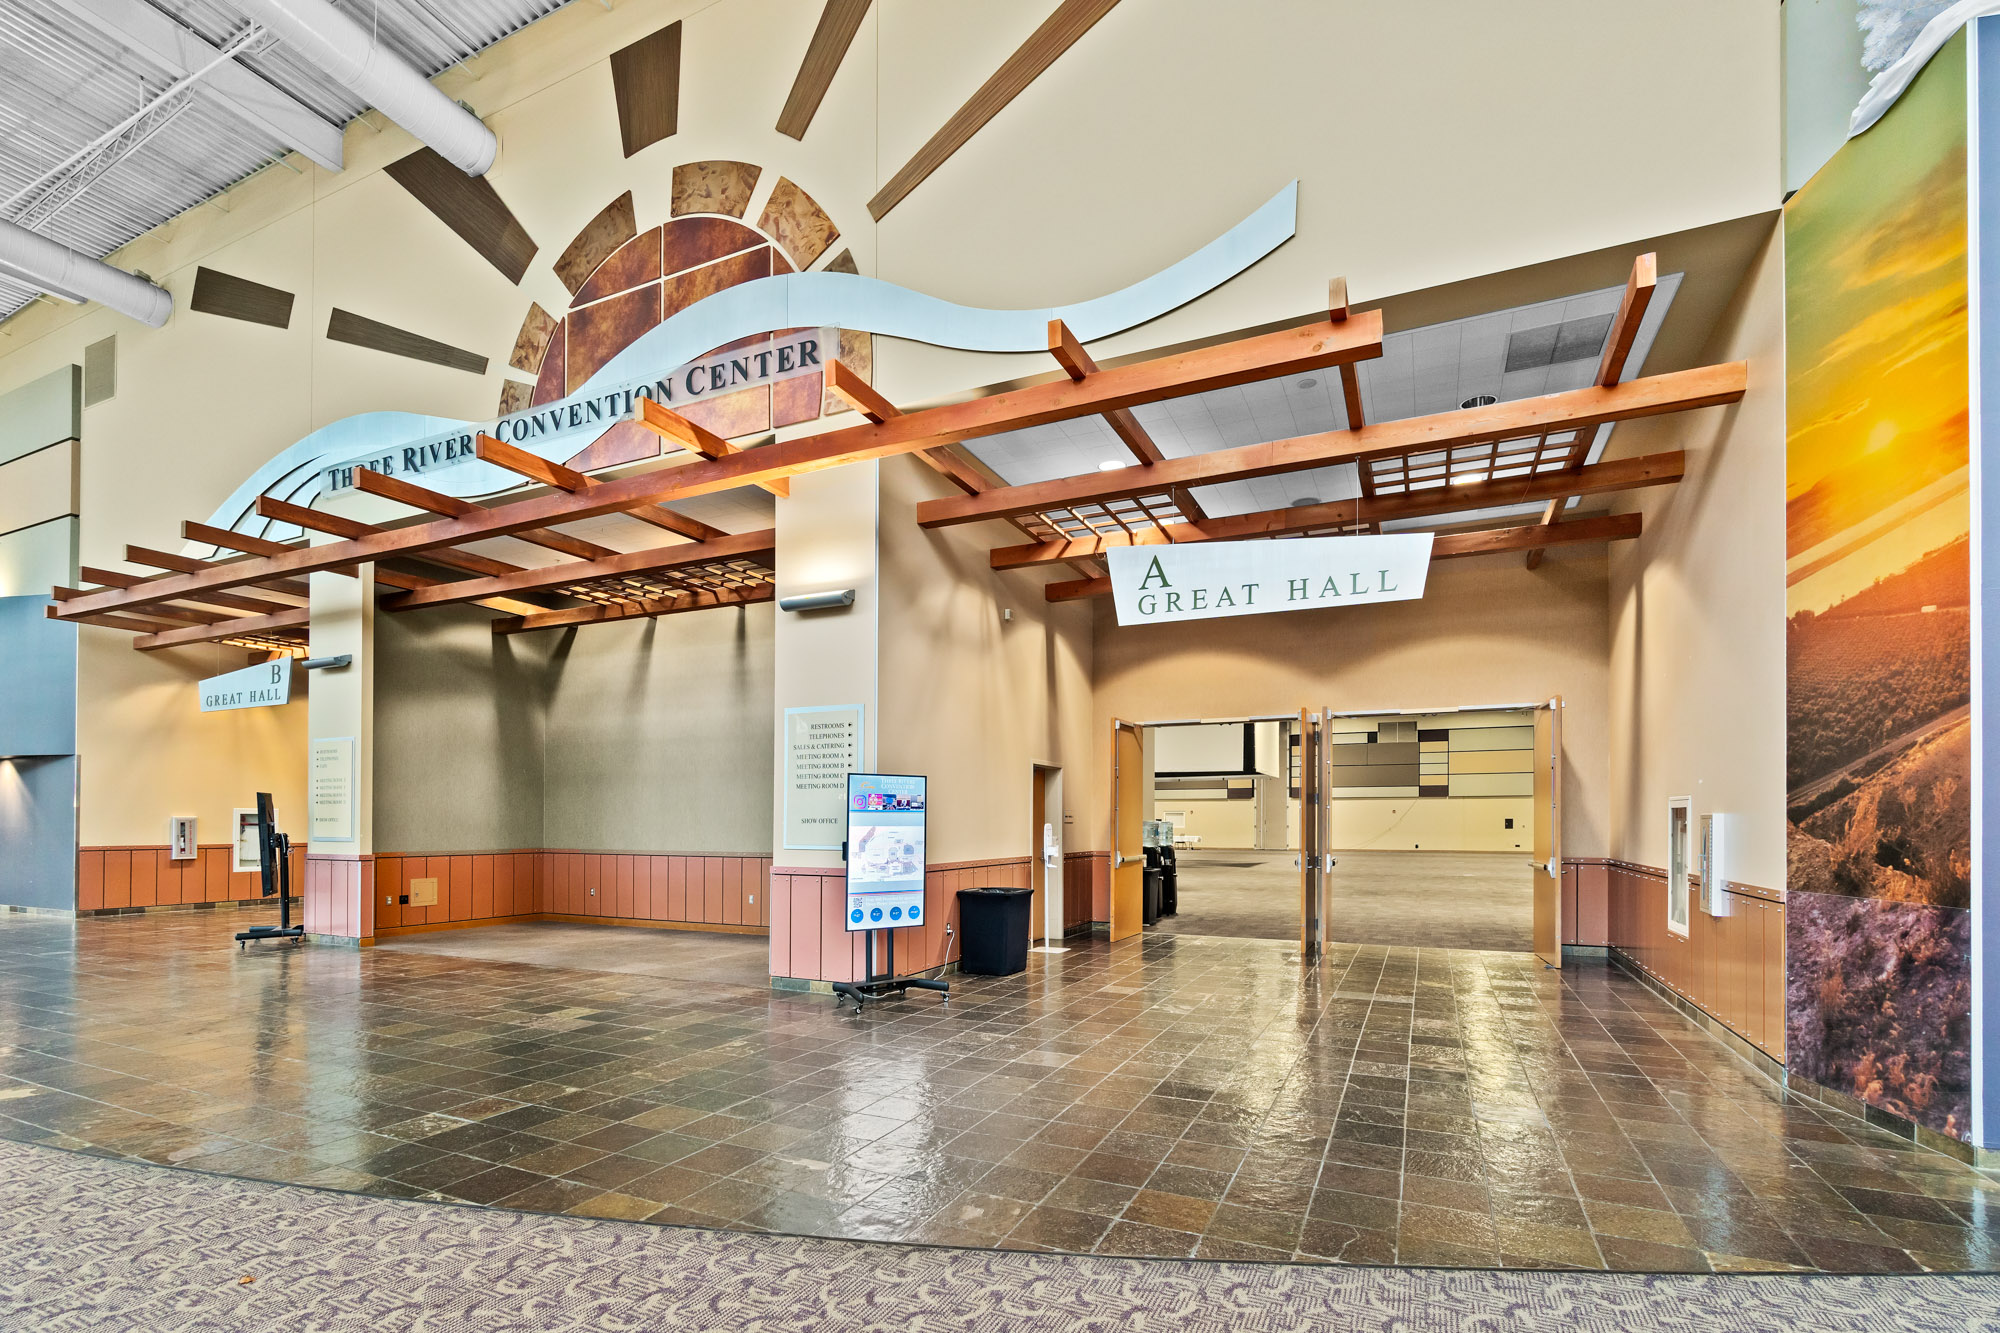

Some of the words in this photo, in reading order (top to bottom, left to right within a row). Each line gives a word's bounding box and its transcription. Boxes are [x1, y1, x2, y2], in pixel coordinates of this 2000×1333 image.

[328, 455, 394, 491] THEE
[402, 429, 486, 473] RIVER
[494, 377, 673, 444] CONVENTION
[685, 338, 821, 396] CENTER
[1138, 554, 1172, 591] A
[1138, 583, 1260, 615] GREAT
[1287, 569, 1399, 601] HALL
[270, 664, 282, 685] B
[206, 692, 243, 707] GREAT
[249, 688, 282, 703] HALL
[809, 732, 845, 740] TELEPHONES
[810, 722, 845, 730] RESTROOMS
[816, 742, 845, 750] CATERING
